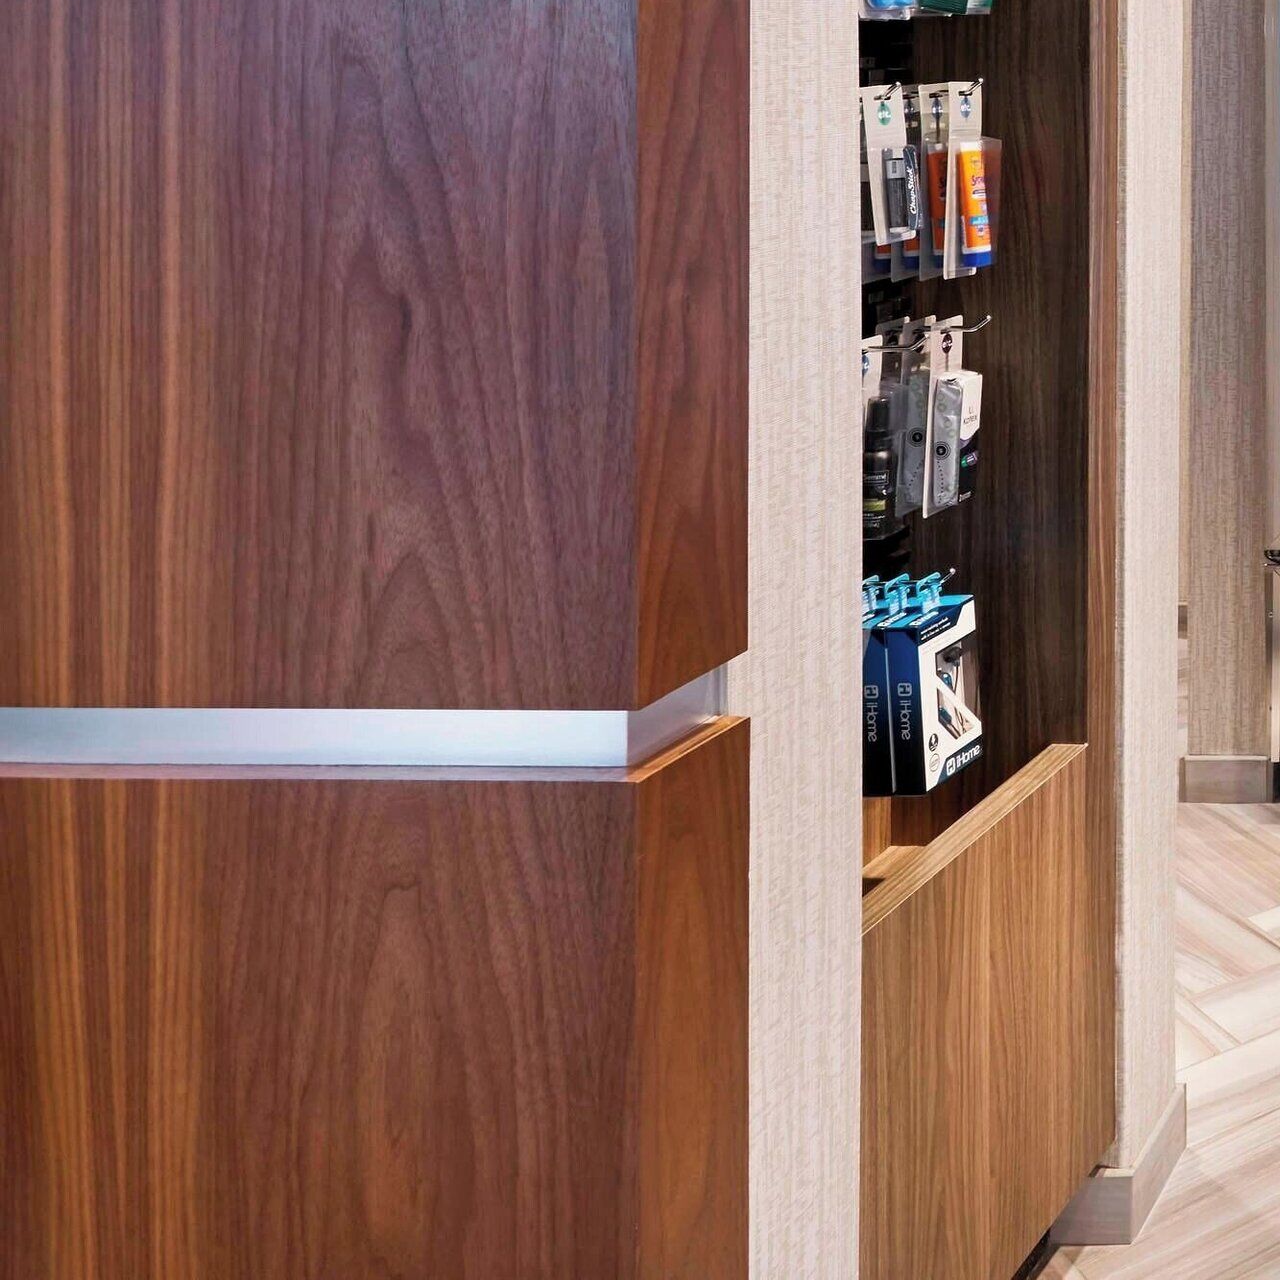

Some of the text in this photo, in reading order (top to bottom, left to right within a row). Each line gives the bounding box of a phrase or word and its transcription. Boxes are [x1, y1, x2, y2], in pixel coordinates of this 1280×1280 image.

[865, 702, 877, 743] iHome
[899, 699, 911, 741] iHome
[956, 744, 980, 769] iHome
